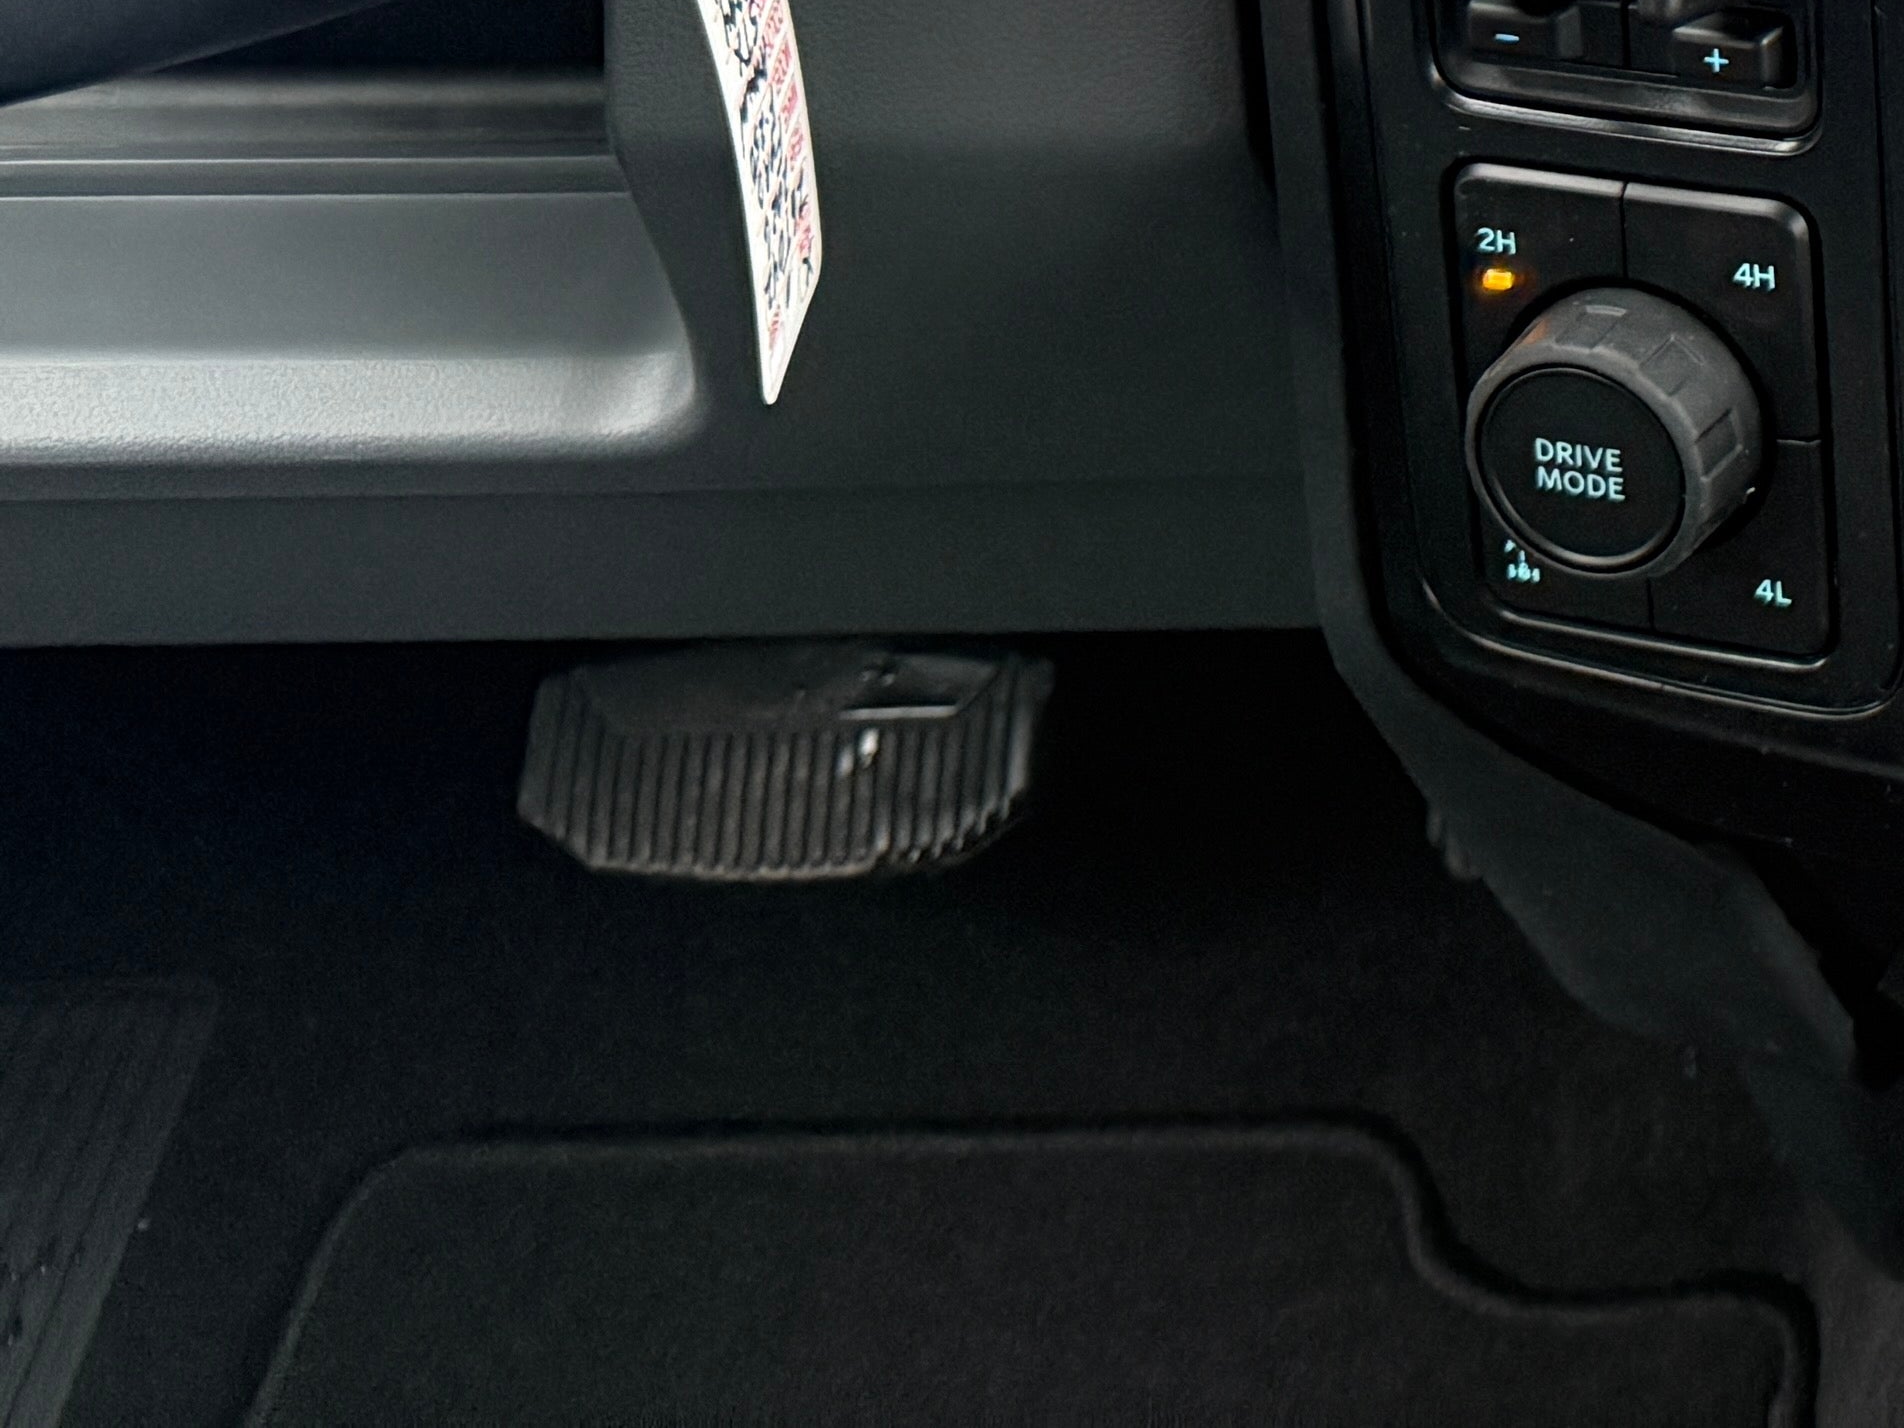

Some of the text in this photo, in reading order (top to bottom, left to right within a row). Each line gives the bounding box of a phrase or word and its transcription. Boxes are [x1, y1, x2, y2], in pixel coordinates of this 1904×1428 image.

[1476, 227, 1518, 256] 2H
[1732, 262, 1777, 291] 4H
[1534, 436, 1622, 473] DRIVE
[1535, 465, 1627, 502] MODE
[1754, 578, 1793, 607] 4L
